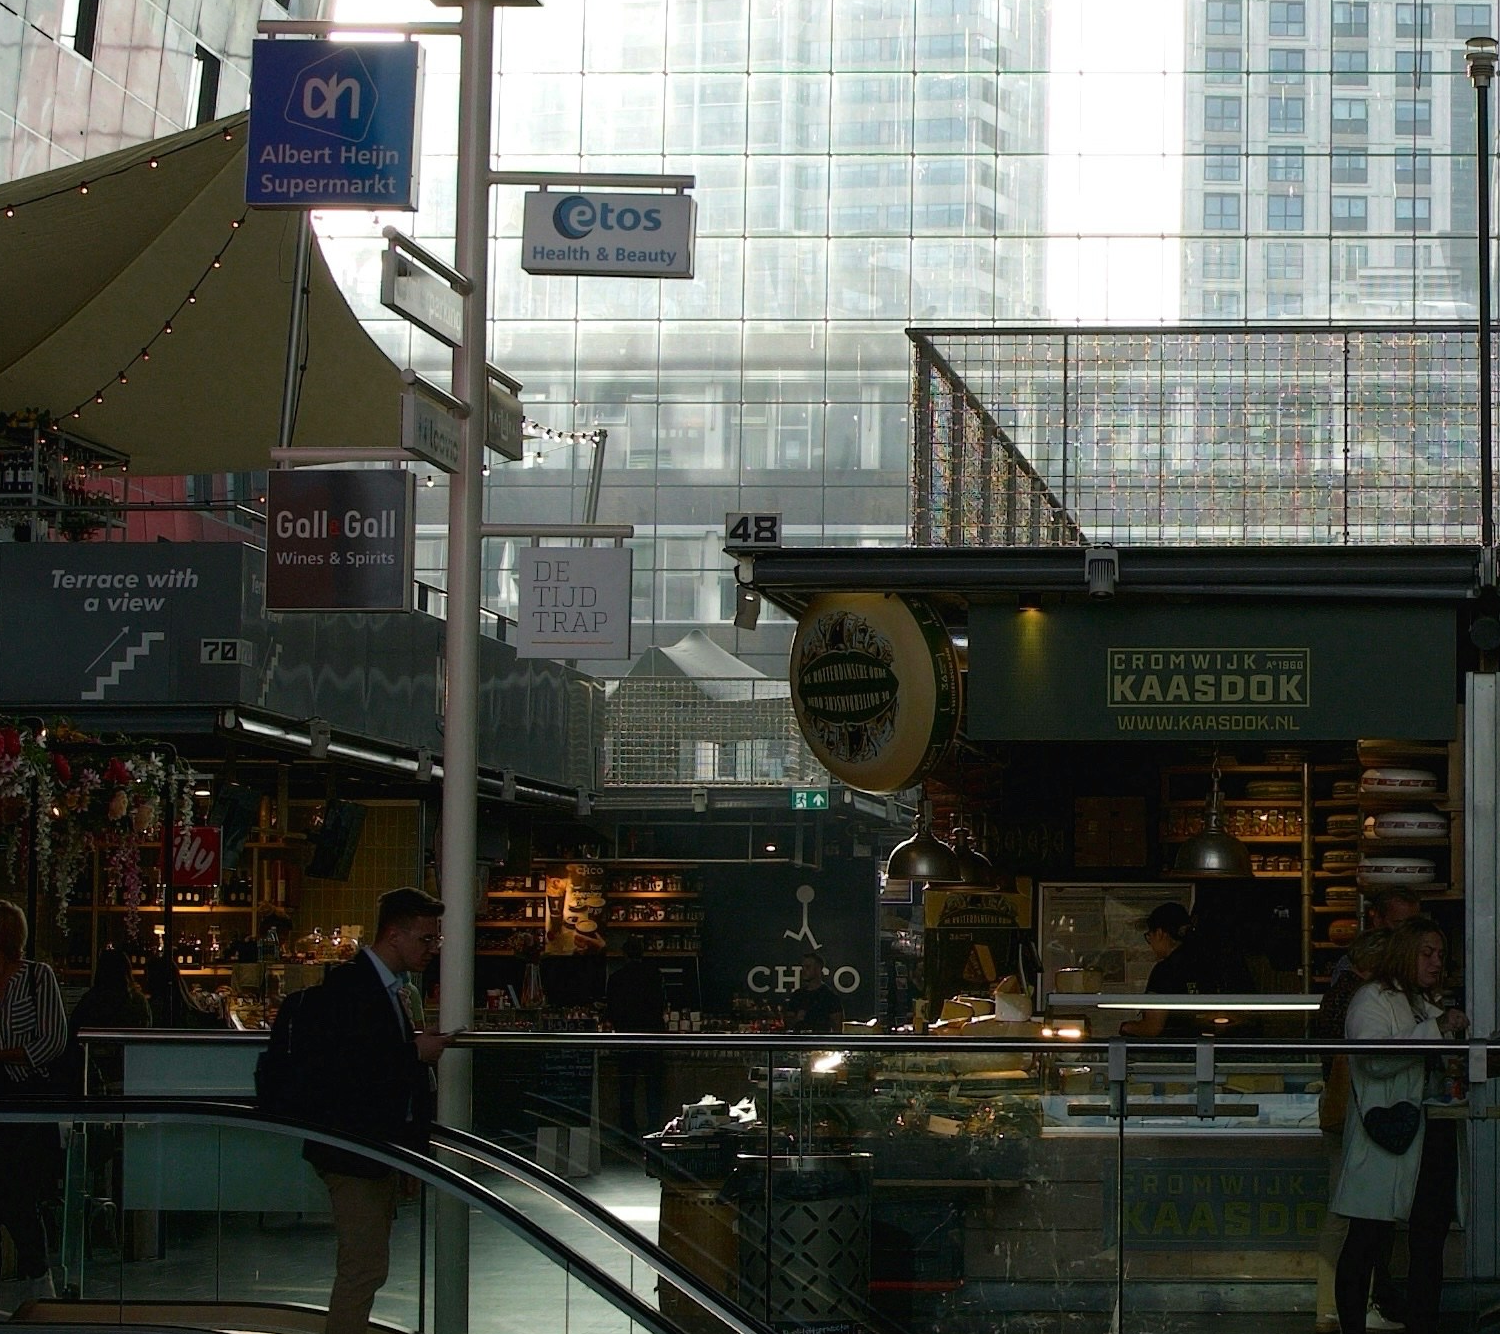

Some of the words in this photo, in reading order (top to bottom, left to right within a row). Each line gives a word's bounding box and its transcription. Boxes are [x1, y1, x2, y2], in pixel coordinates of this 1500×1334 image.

[259, 144, 333, 165] Albert
[339, 145, 399, 169] Heijn
[260, 173, 397, 200] Supermarkt
[532, 245, 590, 262] Health
[595, 247, 610, 262] &
[615, 247, 677, 267] Beauty
[276, 510, 328, 539] Gall
[343, 509, 396, 539] Gall
[729, 516, 777, 543] 48
[276, 551, 324, 566] Wines
[329, 552, 341, 566] &
[346, 551, 395, 568] Spirits
[51, 570, 139, 589] Terrace
[146, 568, 199, 588] with
[533, 560, 570, 582] DE
[84, 595, 100, 612] a
[108, 593, 165, 612] view
[533, 586, 598, 608] TIJD
[533, 611, 609, 633] TRAP
[203, 641, 237, 661] 70
[1113, 653, 1257, 670] CROMWIJK
[1113, 673, 1303, 702] KAASDOK
[1117, 715, 1301, 731] WWW.KAASDOK.NL
